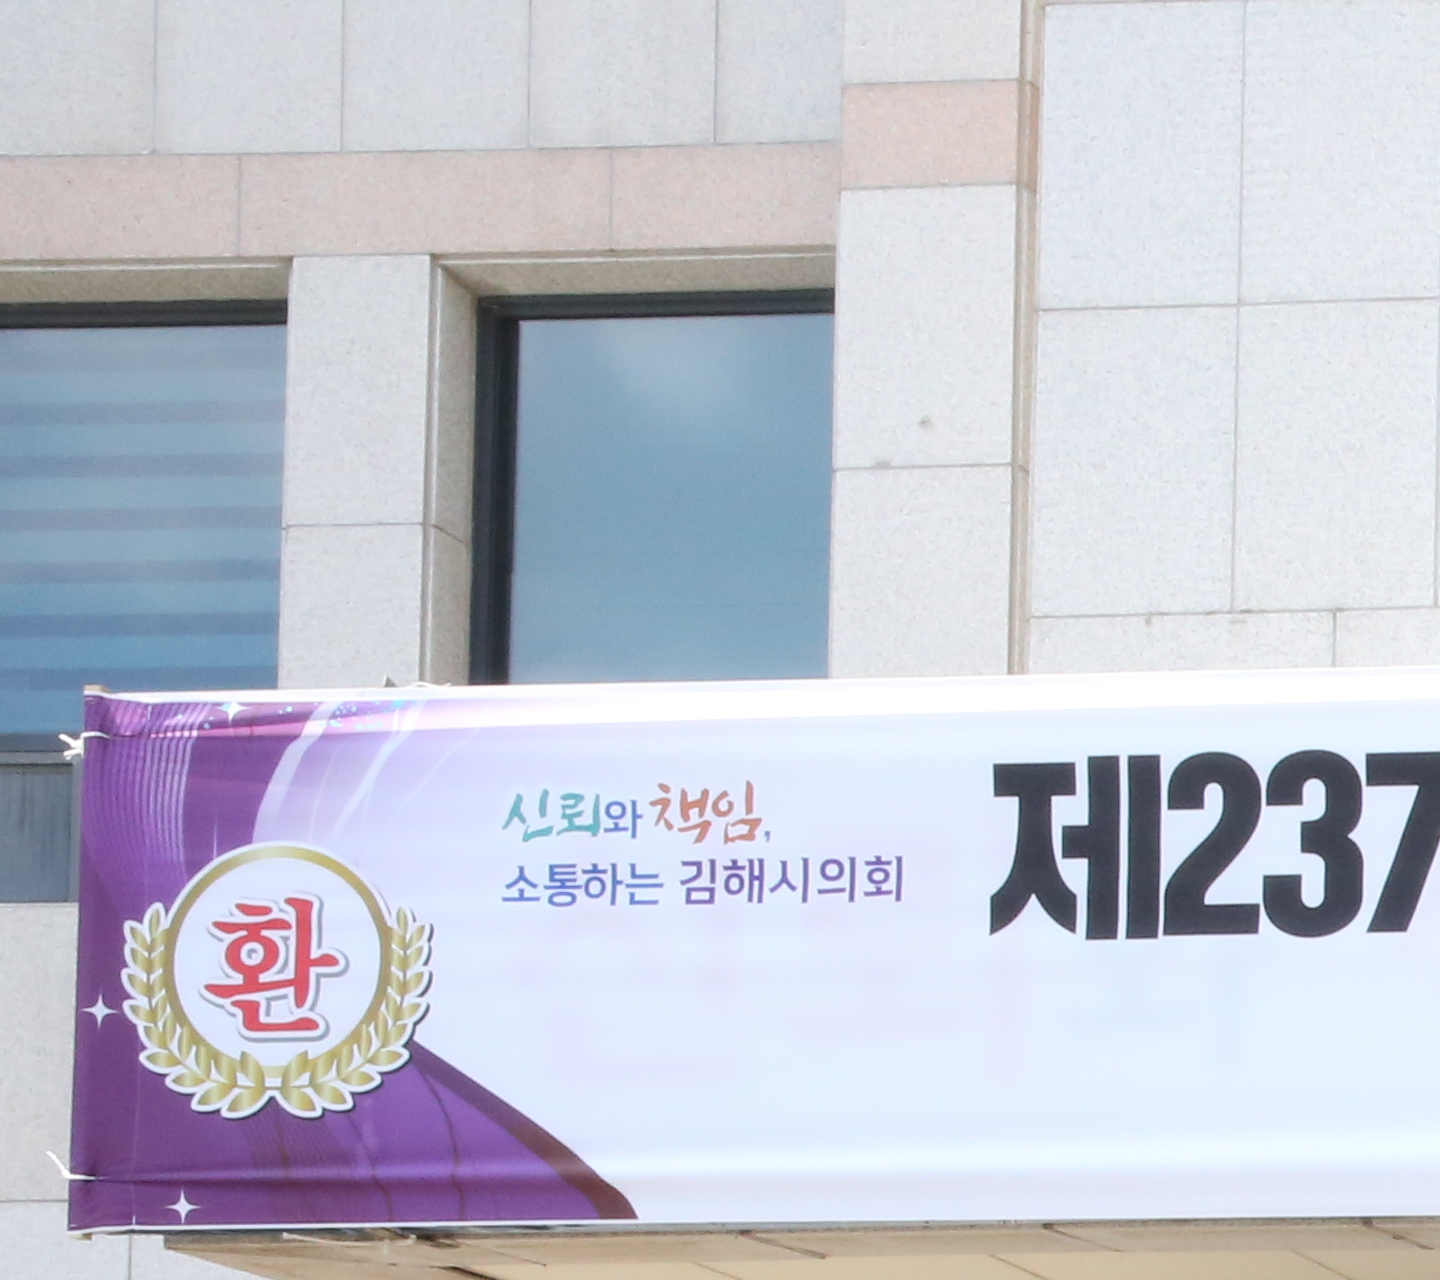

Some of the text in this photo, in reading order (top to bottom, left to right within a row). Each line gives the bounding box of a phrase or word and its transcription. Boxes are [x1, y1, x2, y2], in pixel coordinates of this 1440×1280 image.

[501, 779, 772, 845] 신뢰와 책임,
[501, 854, 904, 908] 소통하는 김해시의회
[204, 896, 342, 1034] 환
